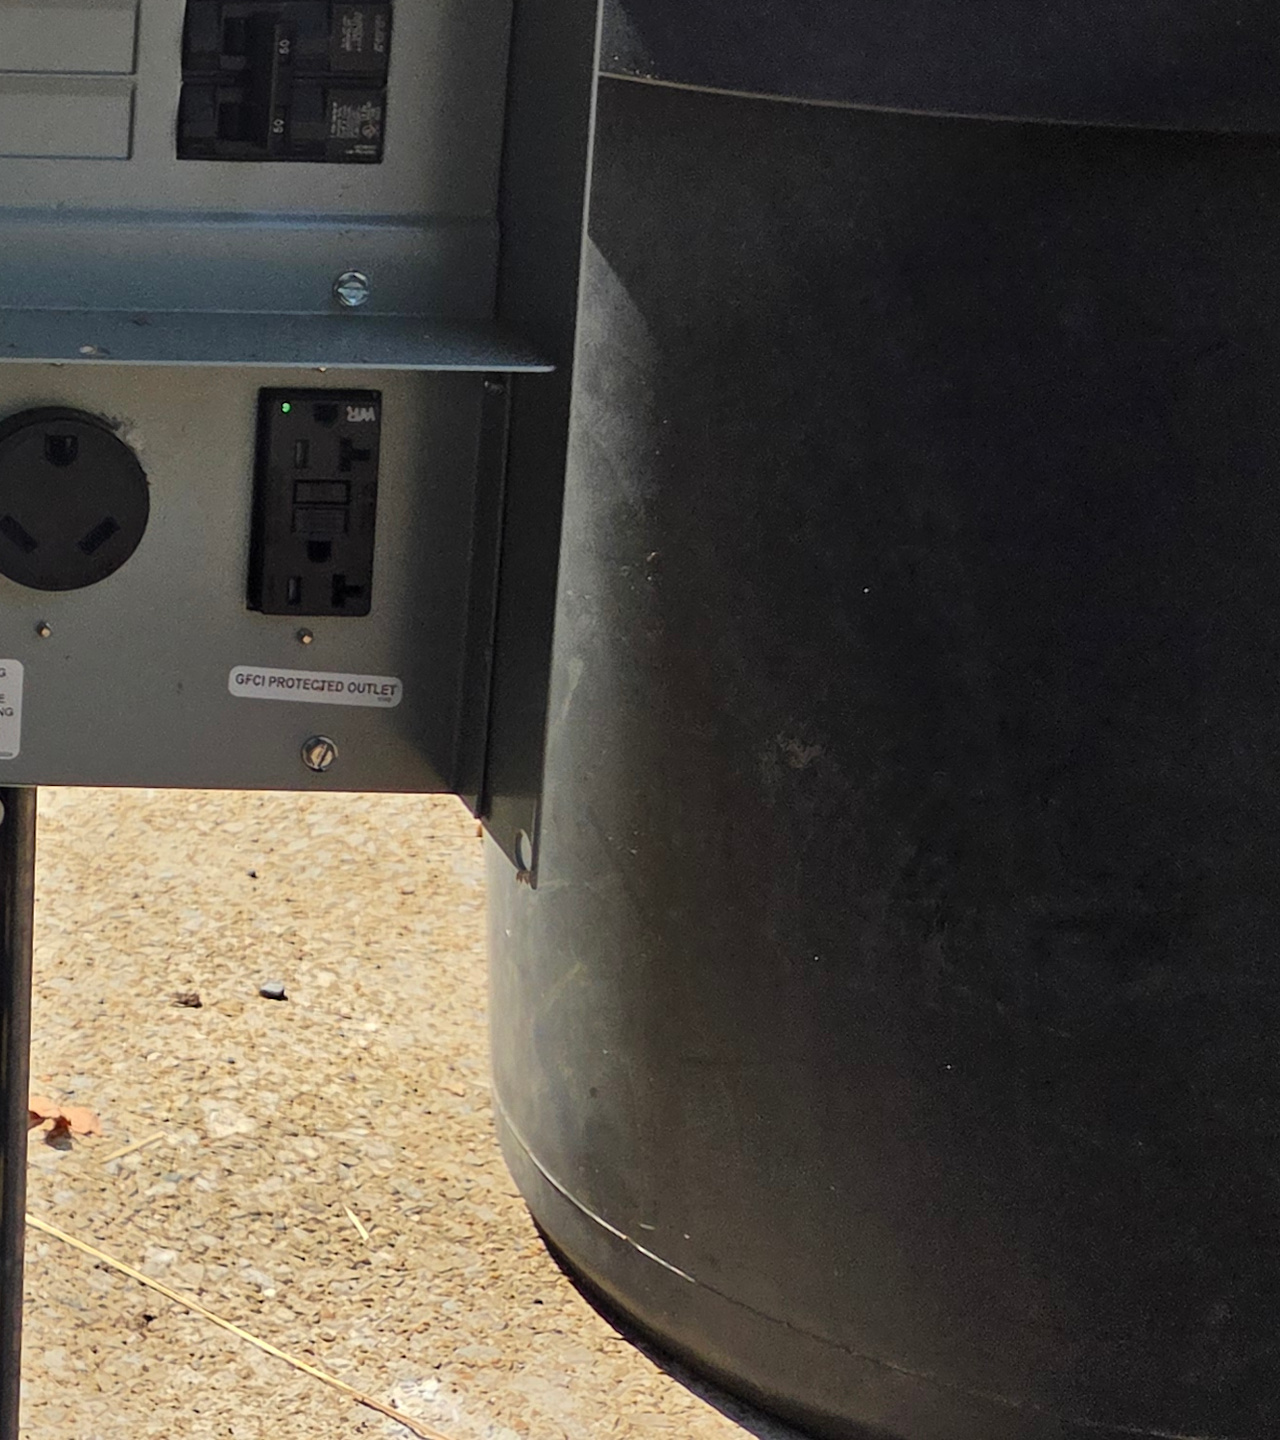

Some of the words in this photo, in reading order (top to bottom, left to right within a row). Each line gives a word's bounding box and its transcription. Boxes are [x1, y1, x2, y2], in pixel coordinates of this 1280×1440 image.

[346, 406, 376, 422] WR
[235, 673, 266, 686] GFCI
[268, 676, 344, 692] PROTECTED
[347, 682, 397, 696] OUTLET
